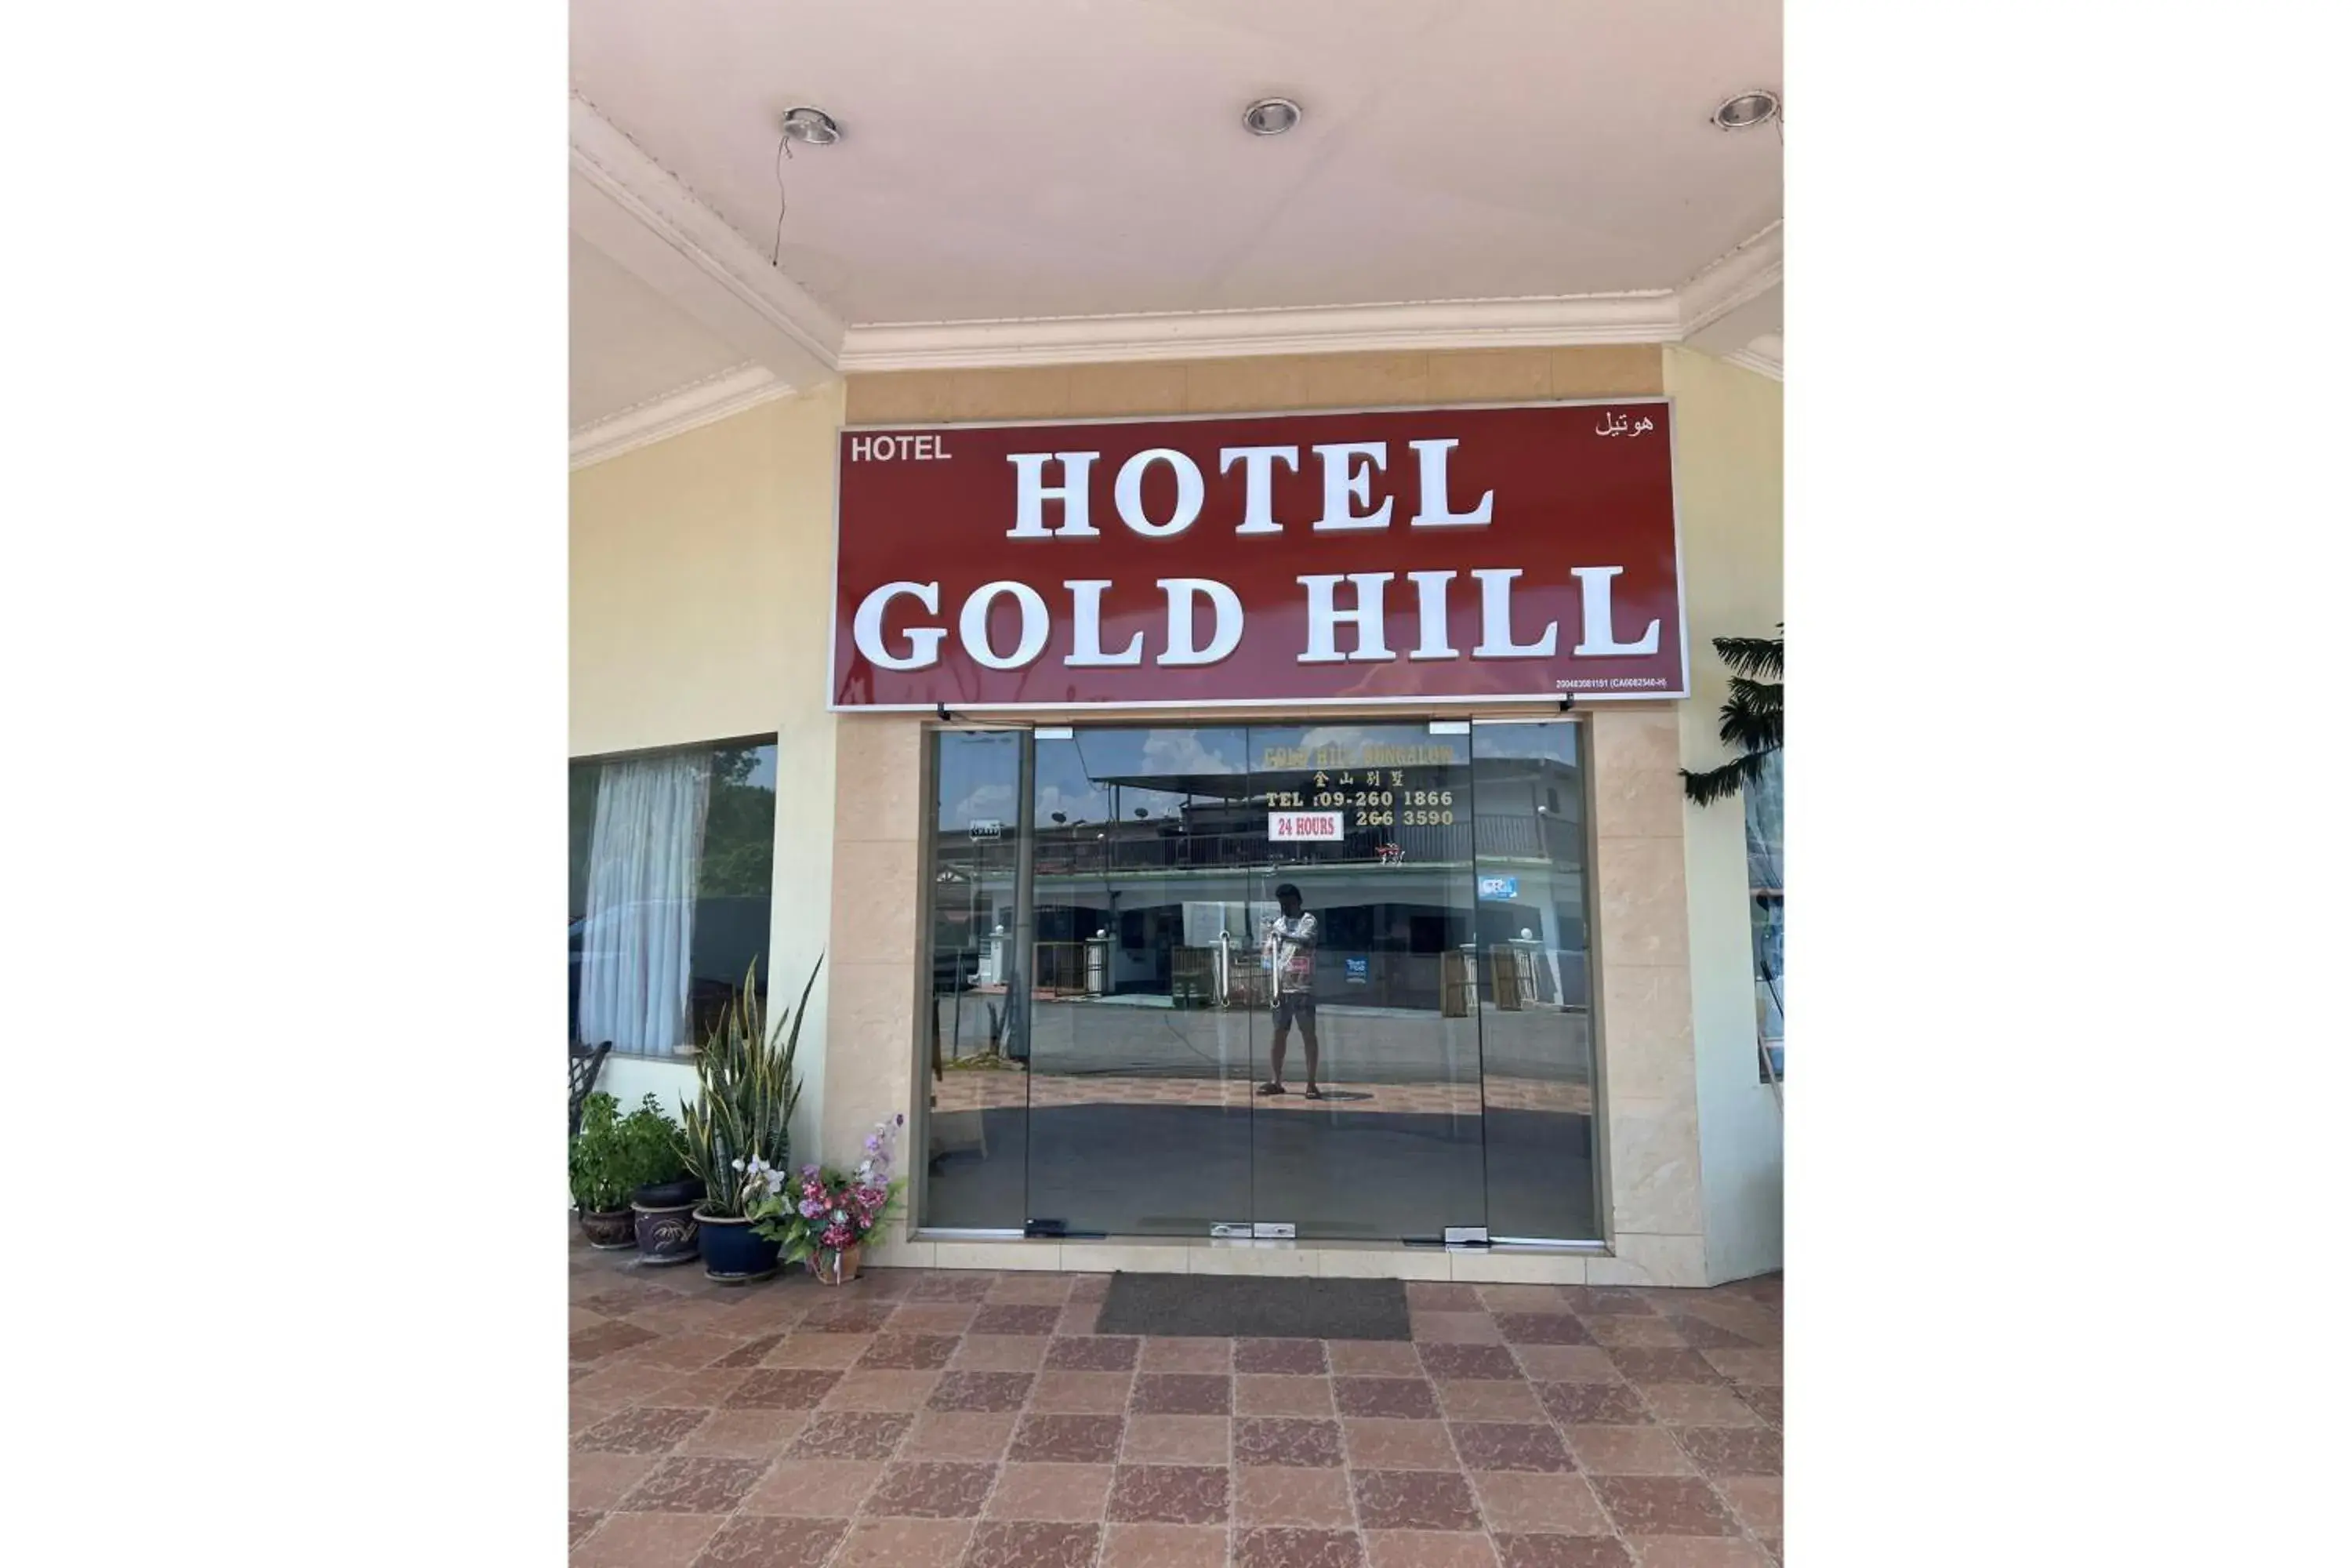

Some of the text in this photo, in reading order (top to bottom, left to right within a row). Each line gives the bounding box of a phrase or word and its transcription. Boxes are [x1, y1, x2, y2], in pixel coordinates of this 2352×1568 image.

[1595, 412, 1653, 437] هوتيل
[851, 435, 952, 461] HOTEL
[1006, 438, 1494, 539] HOTEL
[854, 565, 1661, 670] GOLD HILL
[1363, 744, 1454, 766] BUNGALOW
[1265, 792, 1303, 807] TEL
[1404, 791, 1453, 806] 1866
[1278, 817, 1335, 835] 24 HOURS
[1356, 811, 1453, 826] 266 3590
